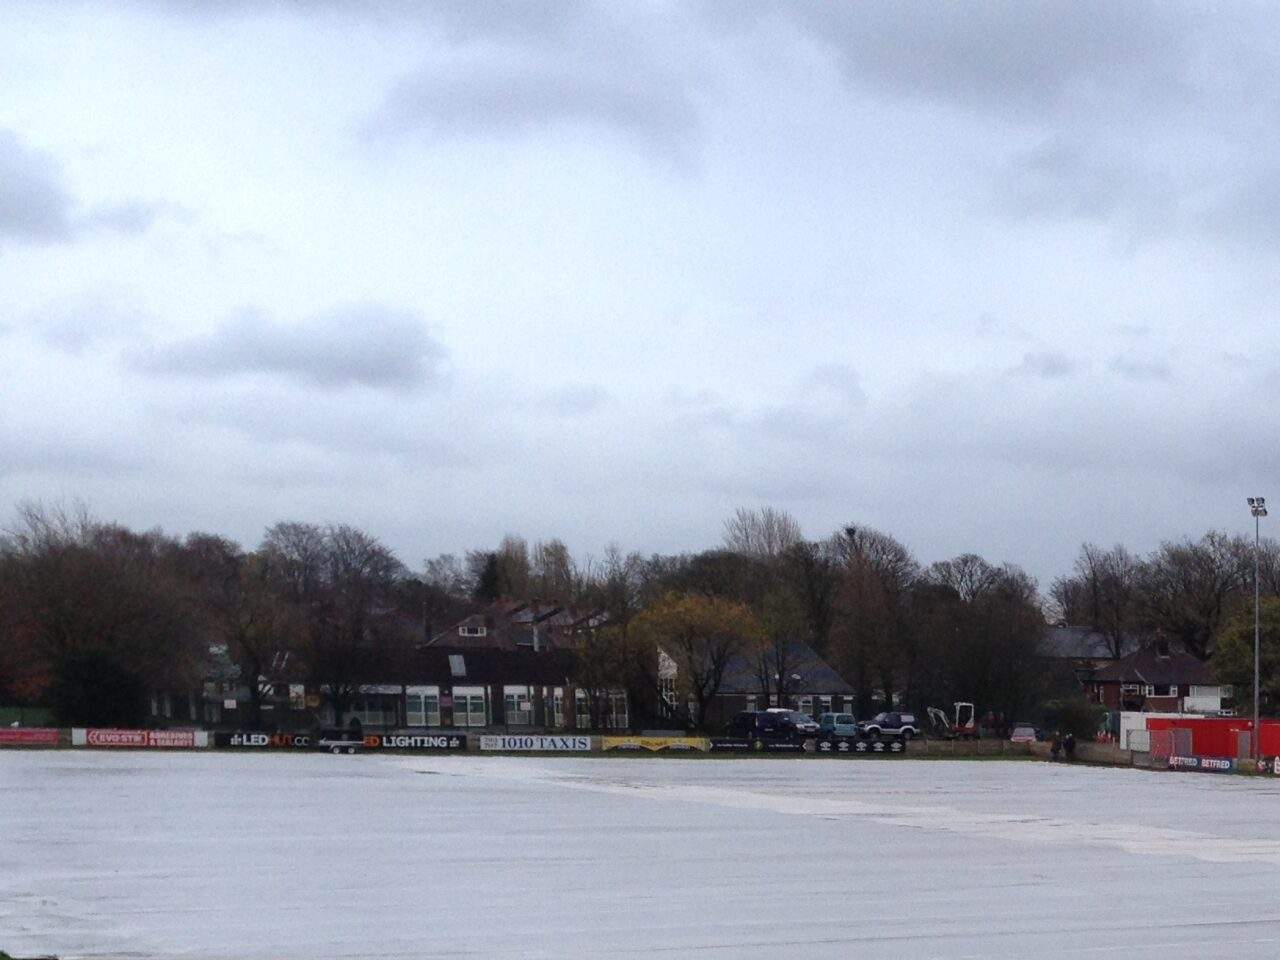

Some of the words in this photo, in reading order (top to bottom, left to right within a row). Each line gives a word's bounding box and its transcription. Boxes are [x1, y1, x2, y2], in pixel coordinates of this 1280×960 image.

[382, 735, 448, 748] LIGHTING
[501, 736, 534, 749] 1010
[536, 736, 589, 749] TAXIS
[1169, 757, 1198, 767] BETFRED
[1201, 758, 1231, 770] BETFRED
